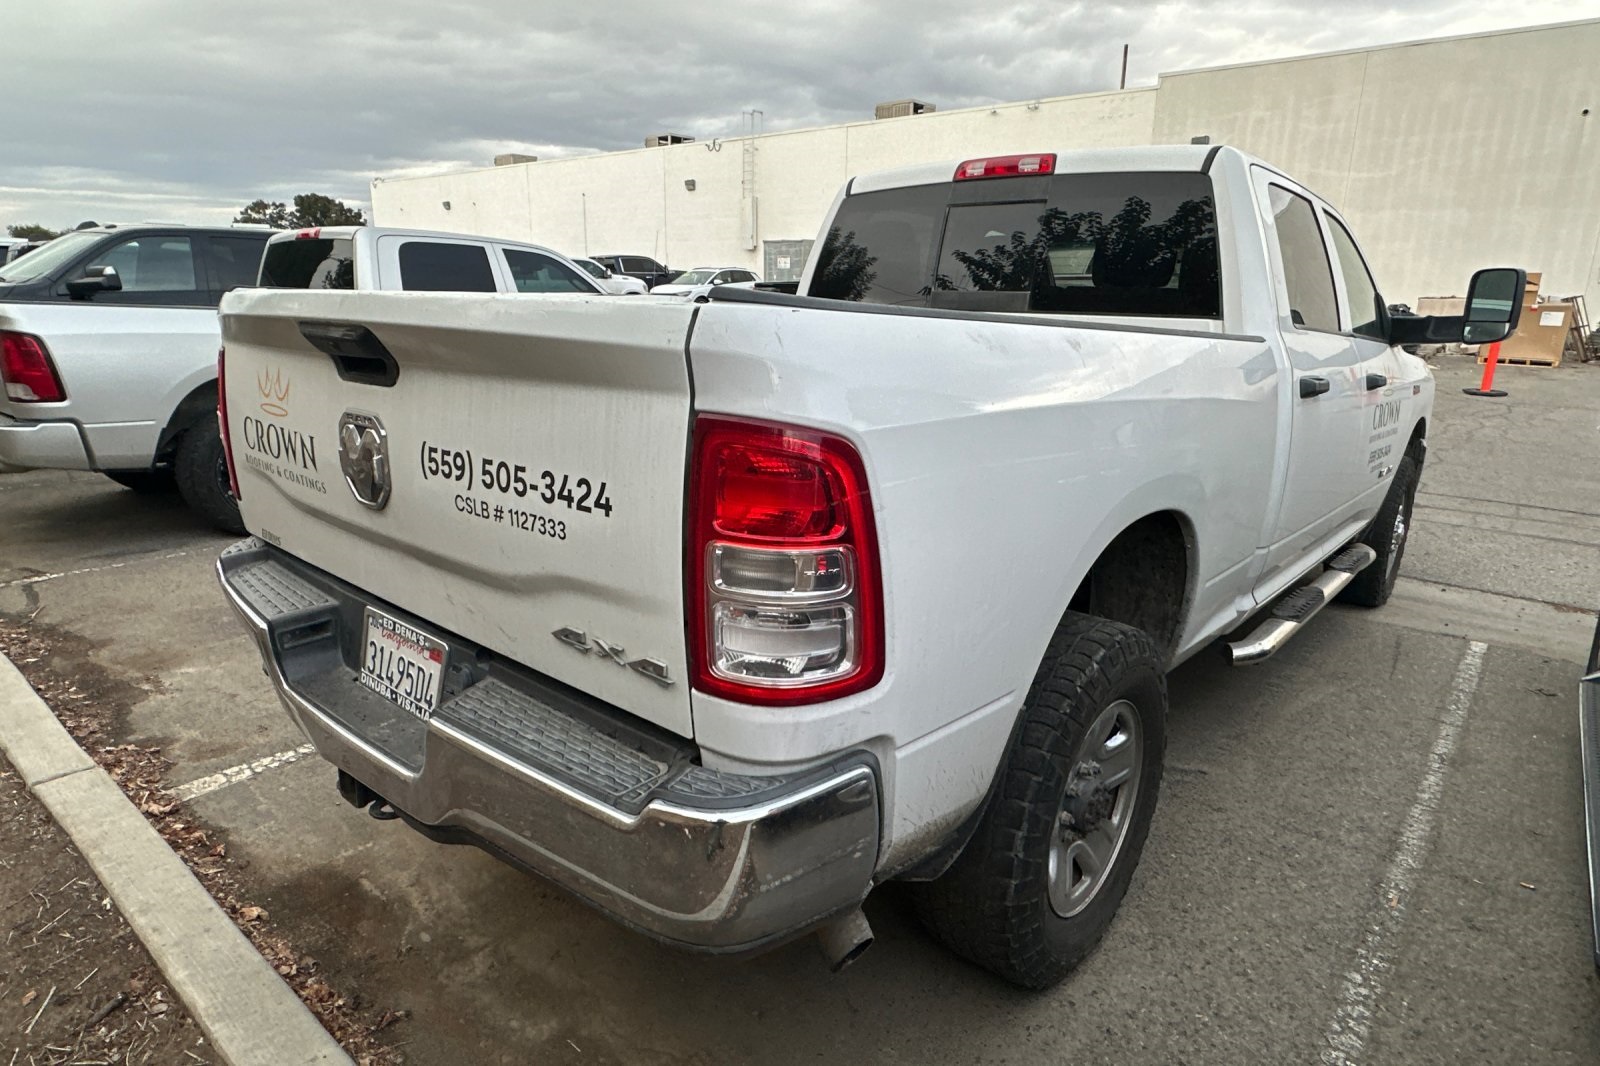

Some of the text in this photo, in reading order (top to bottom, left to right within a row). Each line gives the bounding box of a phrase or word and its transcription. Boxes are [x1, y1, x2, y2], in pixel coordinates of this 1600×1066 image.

[1372, 400, 1401, 430] CROWN
[243, 416, 318, 472] CROWN
[245, 453, 327, 494] ROOFING & COATINGS
[421, 441, 612, 517] (559) 505-3424
[454, 494, 567, 540] CSLB # 1127333
[383, 617, 425, 646] ED DENA'S
[361, 673, 430, 721] DINUBA VISALIA
[367, 640, 433, 709] 31495D4
